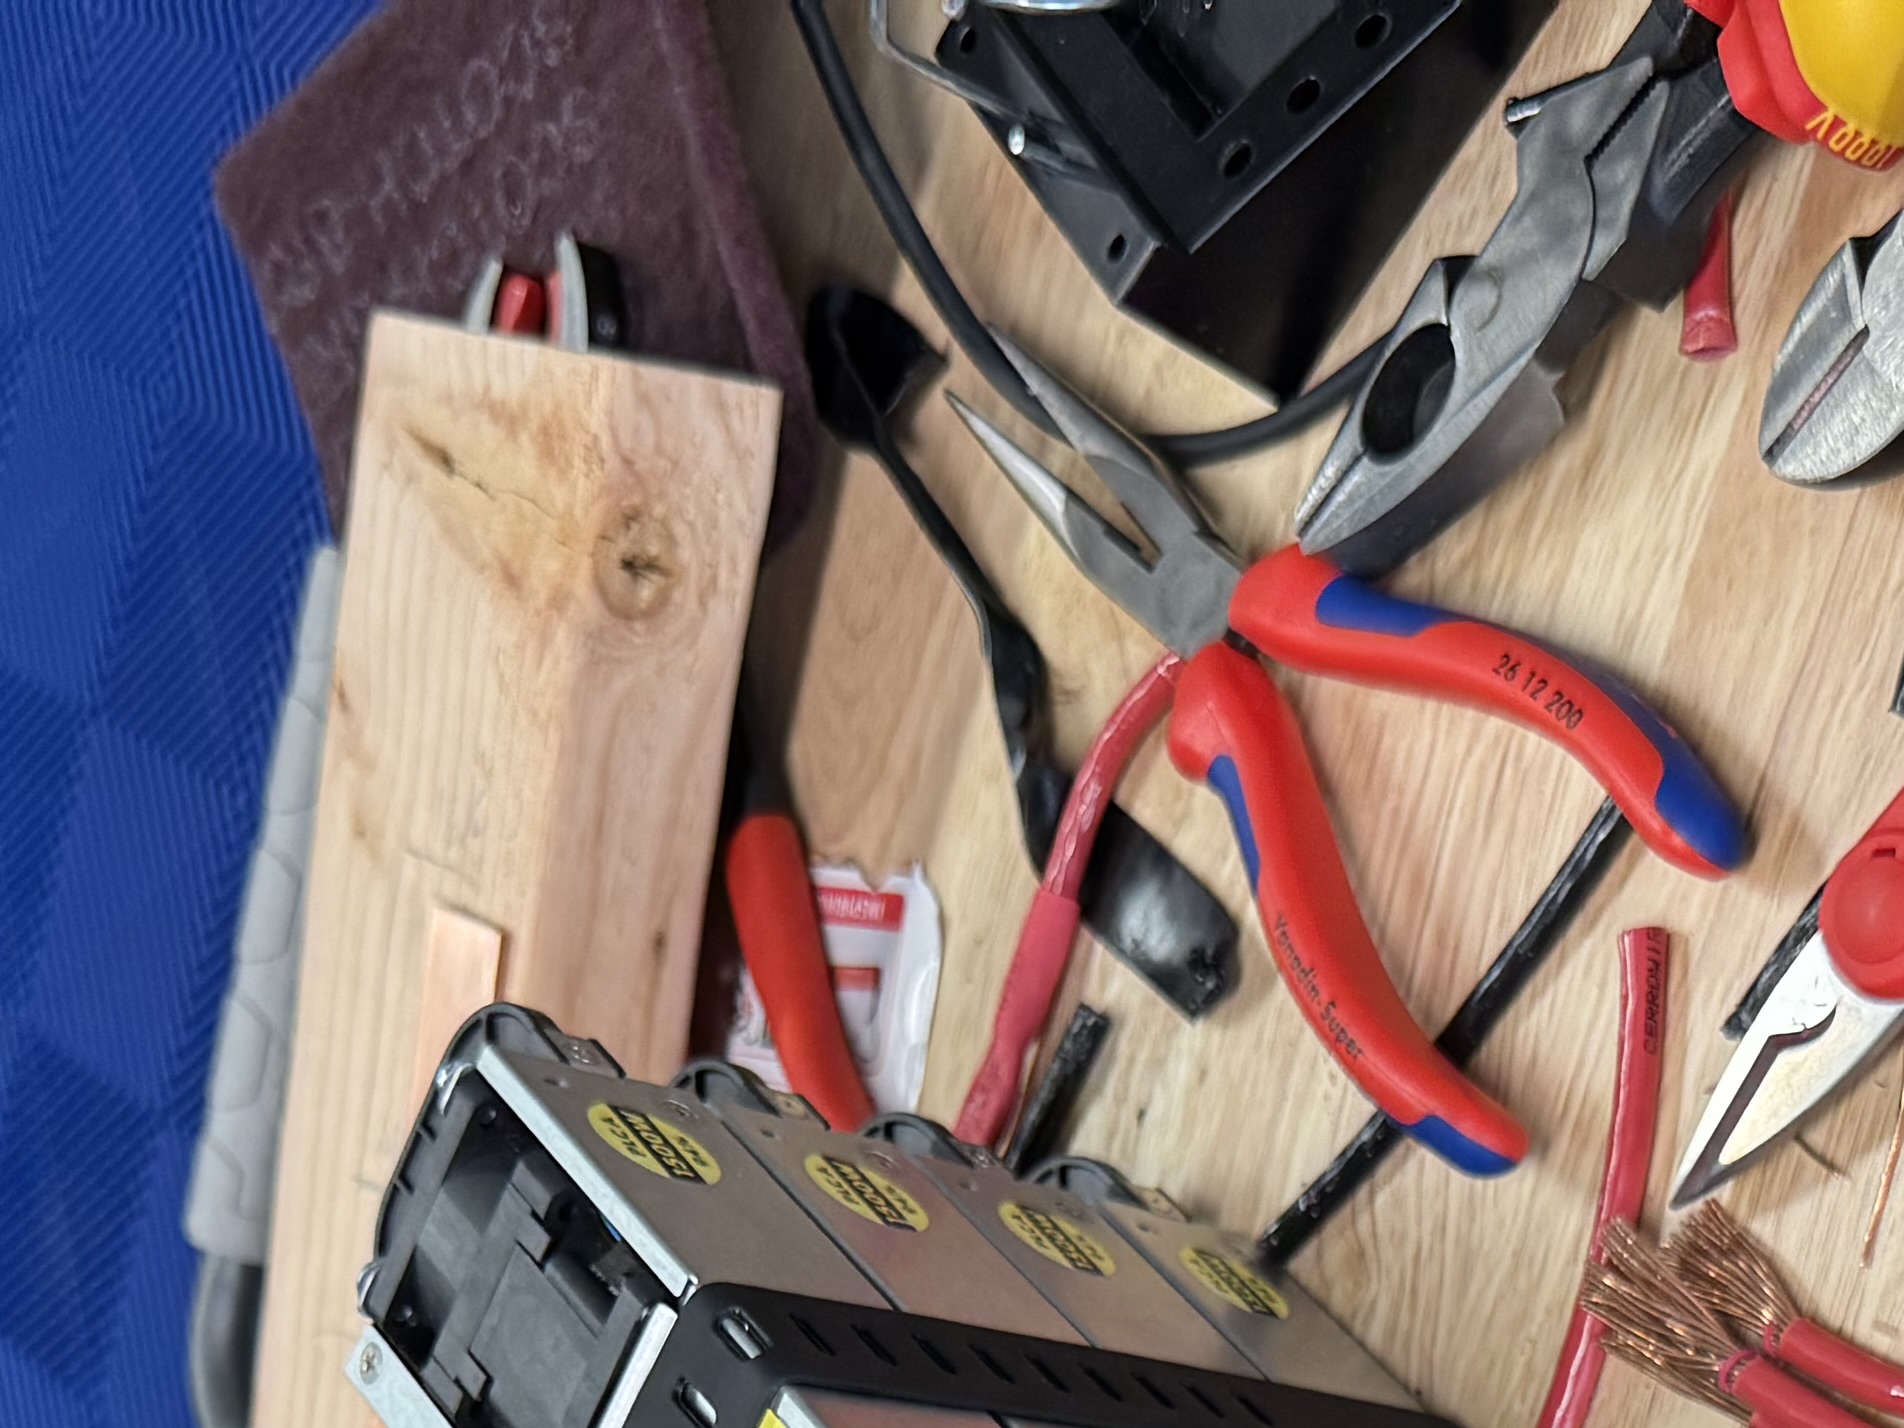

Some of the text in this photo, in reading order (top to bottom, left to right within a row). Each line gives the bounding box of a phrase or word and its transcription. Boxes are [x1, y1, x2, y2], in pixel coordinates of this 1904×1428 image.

[1806, 107, 1894, 170] 1000V
[1492, 653, 1585, 731] 26 12 200
[625, 1110, 695, 1176] 1500W
